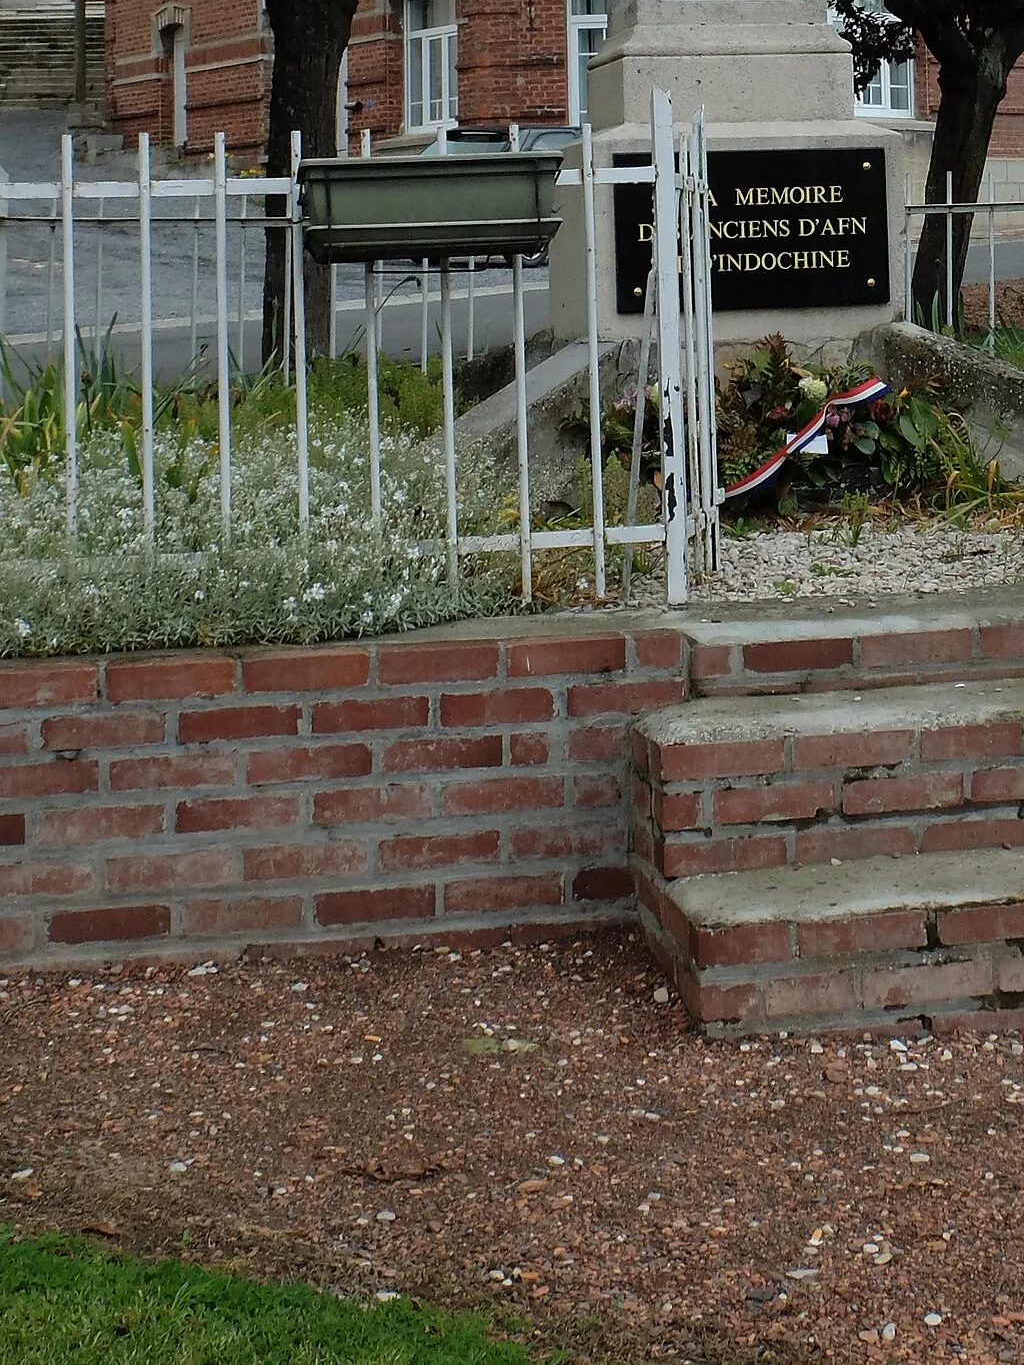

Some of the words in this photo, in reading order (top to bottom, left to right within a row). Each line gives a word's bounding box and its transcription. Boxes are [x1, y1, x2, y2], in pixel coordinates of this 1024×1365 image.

[734, 185, 844, 206] MEMOIRE
[691, 218, 791, 240] NCIENS
[797, 216, 868, 237] D'AFN
[709, 249, 851, 273] 'INDOCHINE
